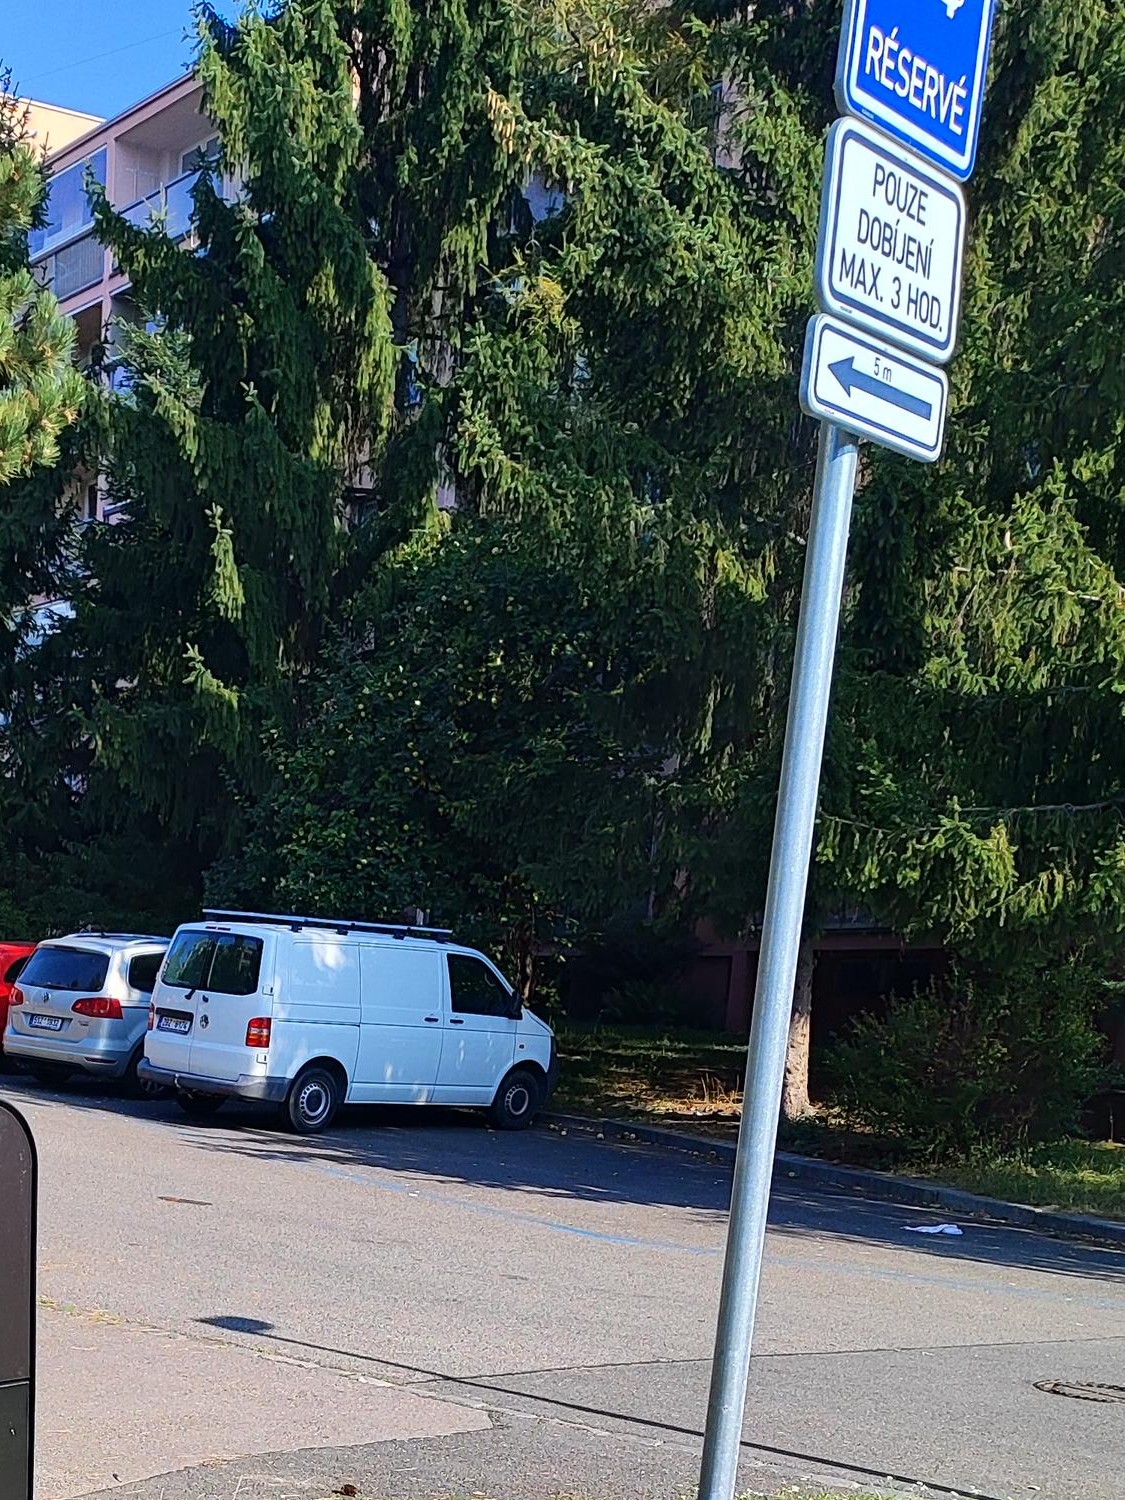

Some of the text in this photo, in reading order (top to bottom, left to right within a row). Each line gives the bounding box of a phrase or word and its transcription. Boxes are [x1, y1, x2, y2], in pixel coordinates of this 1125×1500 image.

[865, 25, 967, 136] RÉSERVÉ
[873, 162, 928, 226] POUZE
[857, 208, 934, 280] DOBÍJENÍ
[839, 247, 942, 333] MAX. 3 HOD.
[873, 357, 892, 382] 5 m
